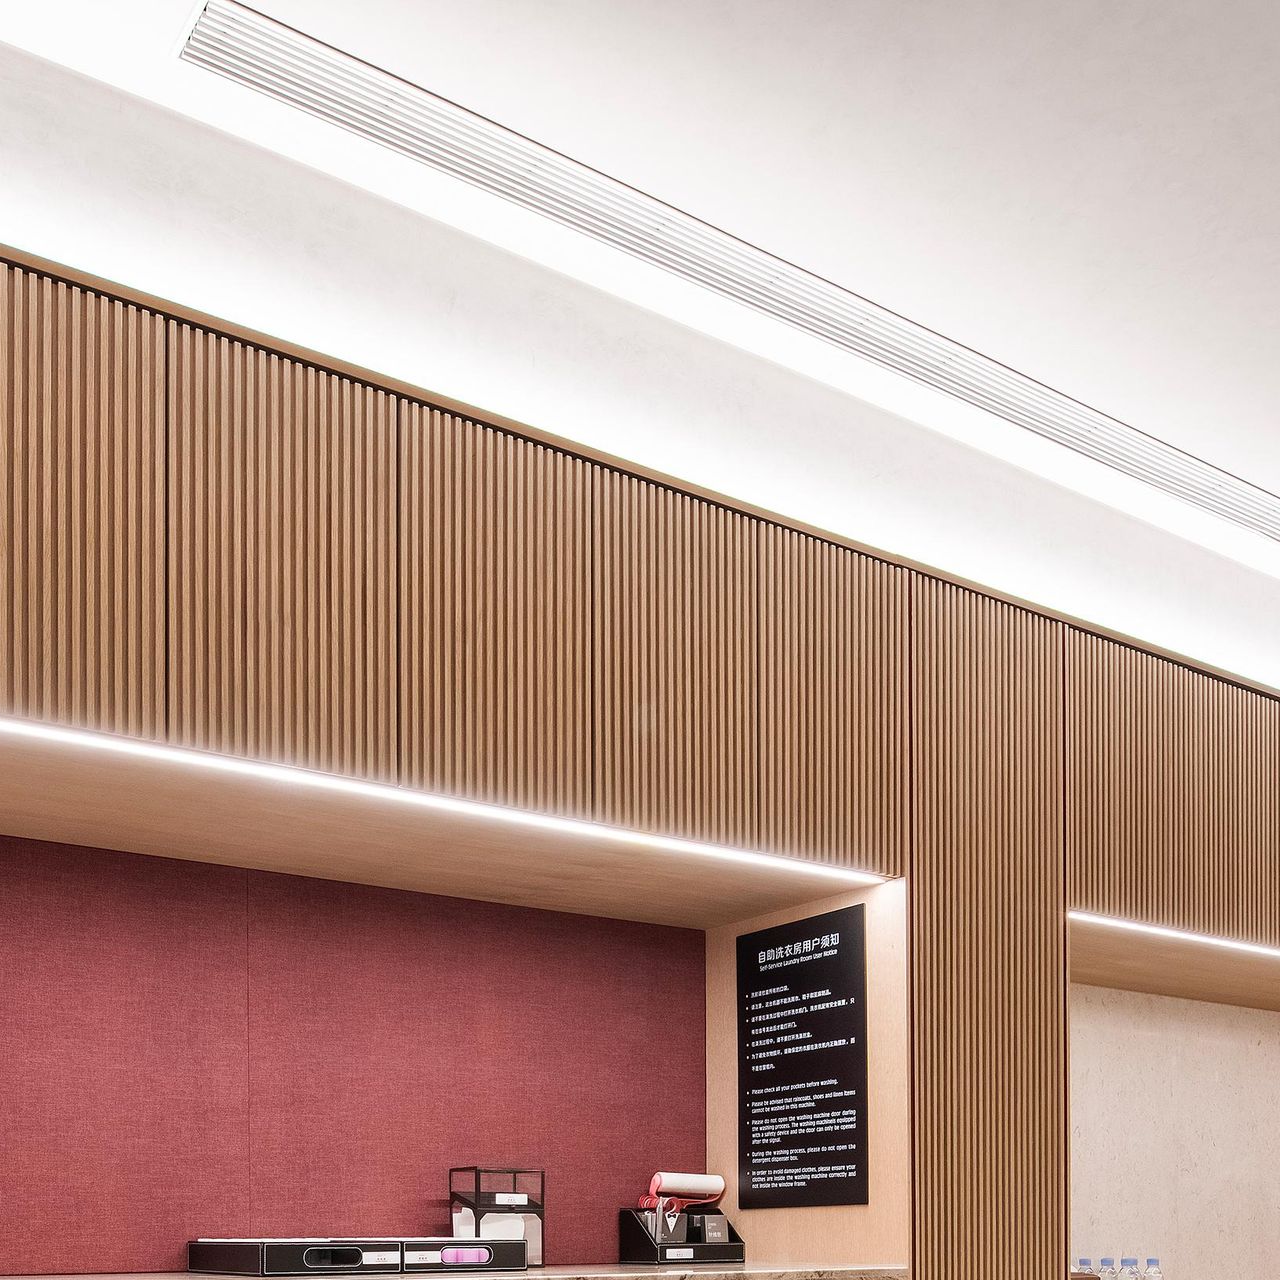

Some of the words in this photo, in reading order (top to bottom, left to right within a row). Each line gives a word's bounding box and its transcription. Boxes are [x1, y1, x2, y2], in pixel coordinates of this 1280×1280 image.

[758, 933, 839, 964] 自助洗衣房用户须知
[759, 962, 782, 972] Self-Service
[783, 956, 799, 967] Laundry
[800, 954, 812, 962] Room
[813, 951, 822, 959] User
[824, 949, 838, 957] Notice
